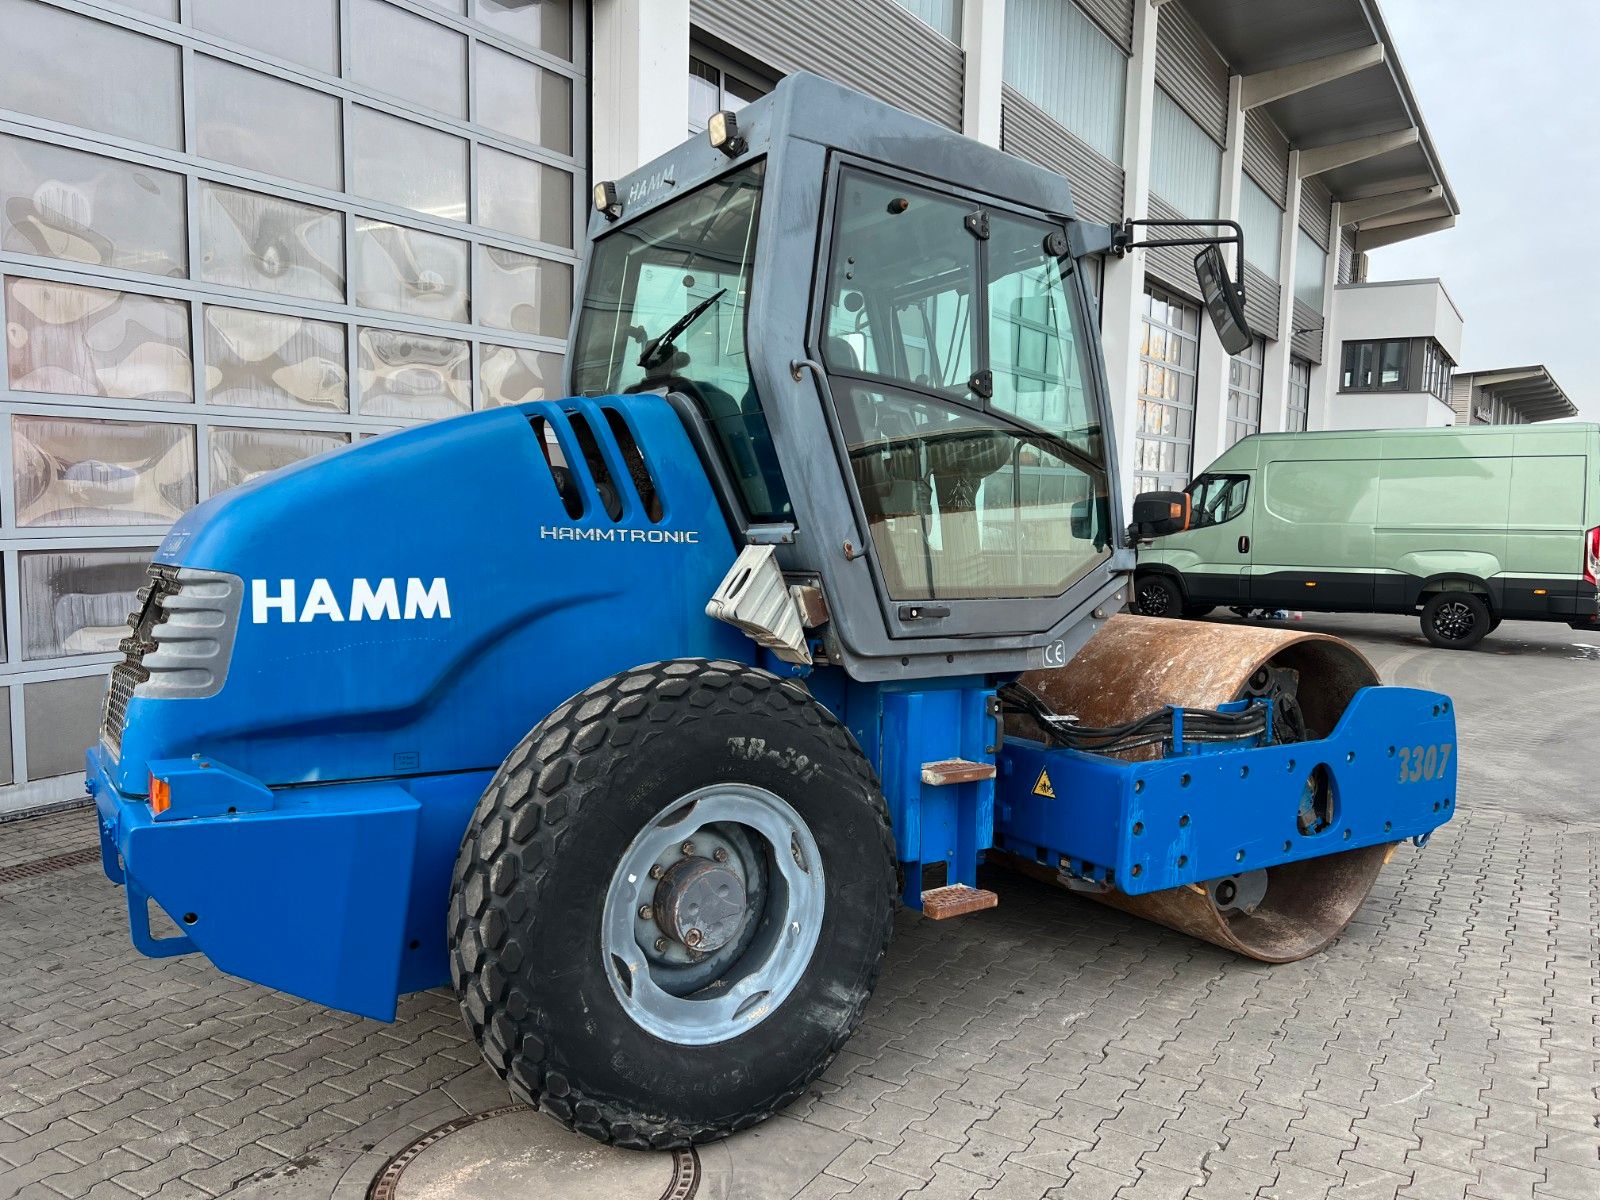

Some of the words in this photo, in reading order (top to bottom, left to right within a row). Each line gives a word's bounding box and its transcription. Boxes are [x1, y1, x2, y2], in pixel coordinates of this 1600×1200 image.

[628, 164, 674, 205] HAMM
[540, 525, 699, 543] HAMMTRONIC
[252, 577, 451, 624] HAMM
[1398, 743, 1452, 784] 3307
